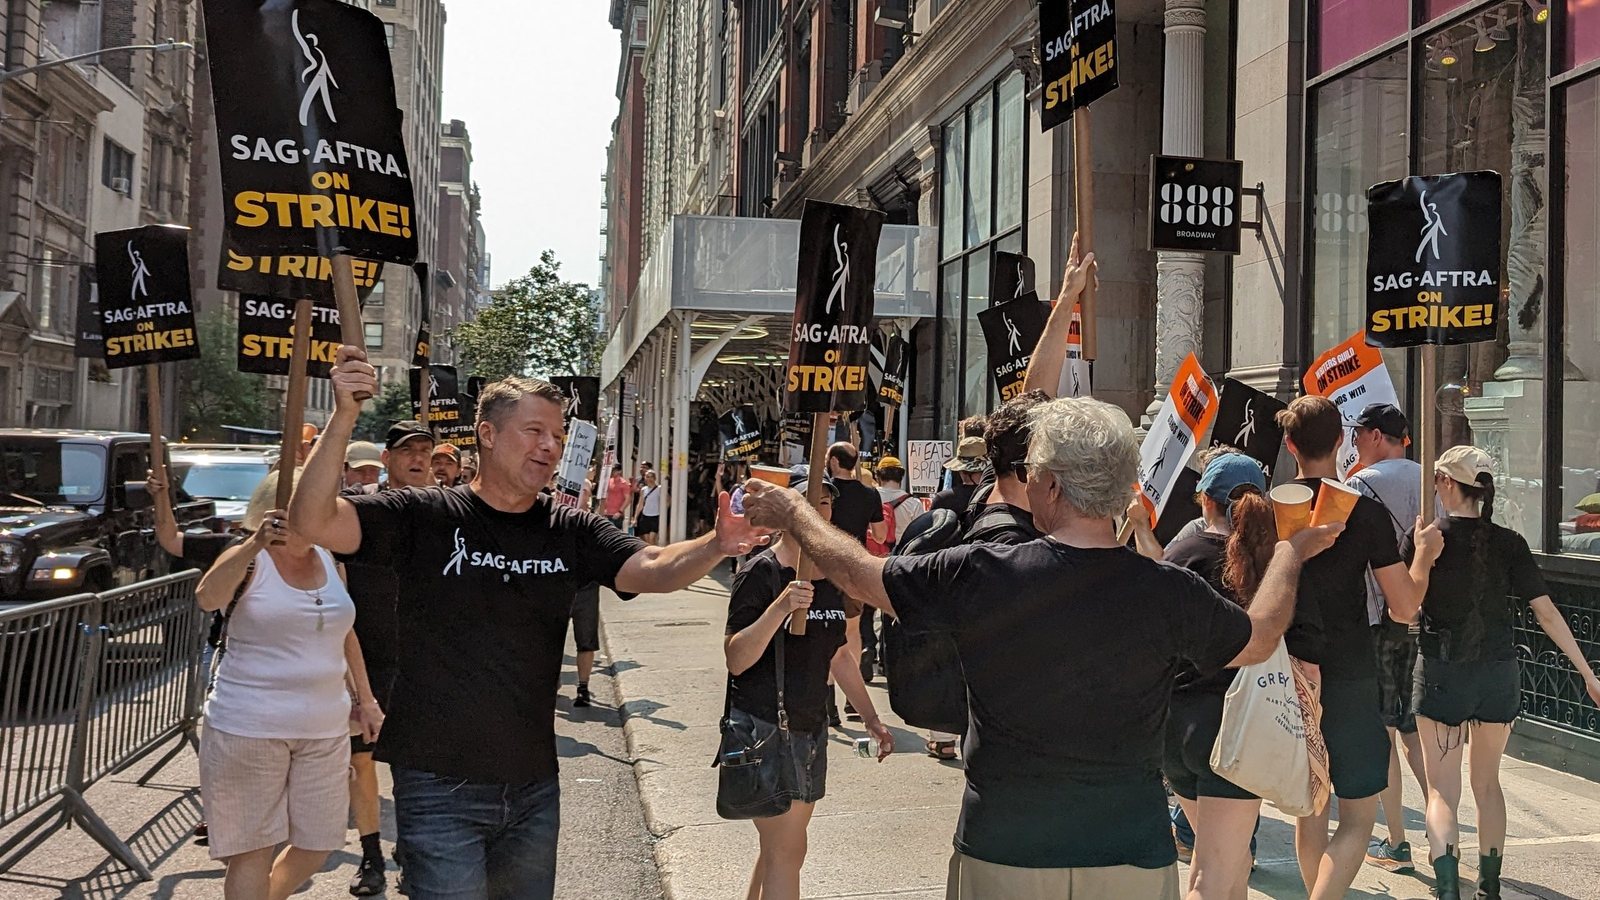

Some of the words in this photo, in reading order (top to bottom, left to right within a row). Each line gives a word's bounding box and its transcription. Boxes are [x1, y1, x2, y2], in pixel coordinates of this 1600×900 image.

[311, 171, 350, 191] ON
[1160, 183, 1234, 227] 888
[234, 190, 412, 239] STRIKE!
[1176, 230, 1216, 239] BROADWAY
[1417, 291, 1442, 303] ON
[136, 321, 154, 332] ON
[1371, 303, 1494, 333] STRIKE!
[105, 328, 194, 356] STRIKE!
[1327, 354, 1361, 385] STRIKE
[1348, 384, 1366, 400] WITH
[414, 411, 459, 422] SRIKE!
[924, 442, 952, 460] EATS
[1257, 672, 1290, 688] GREY
